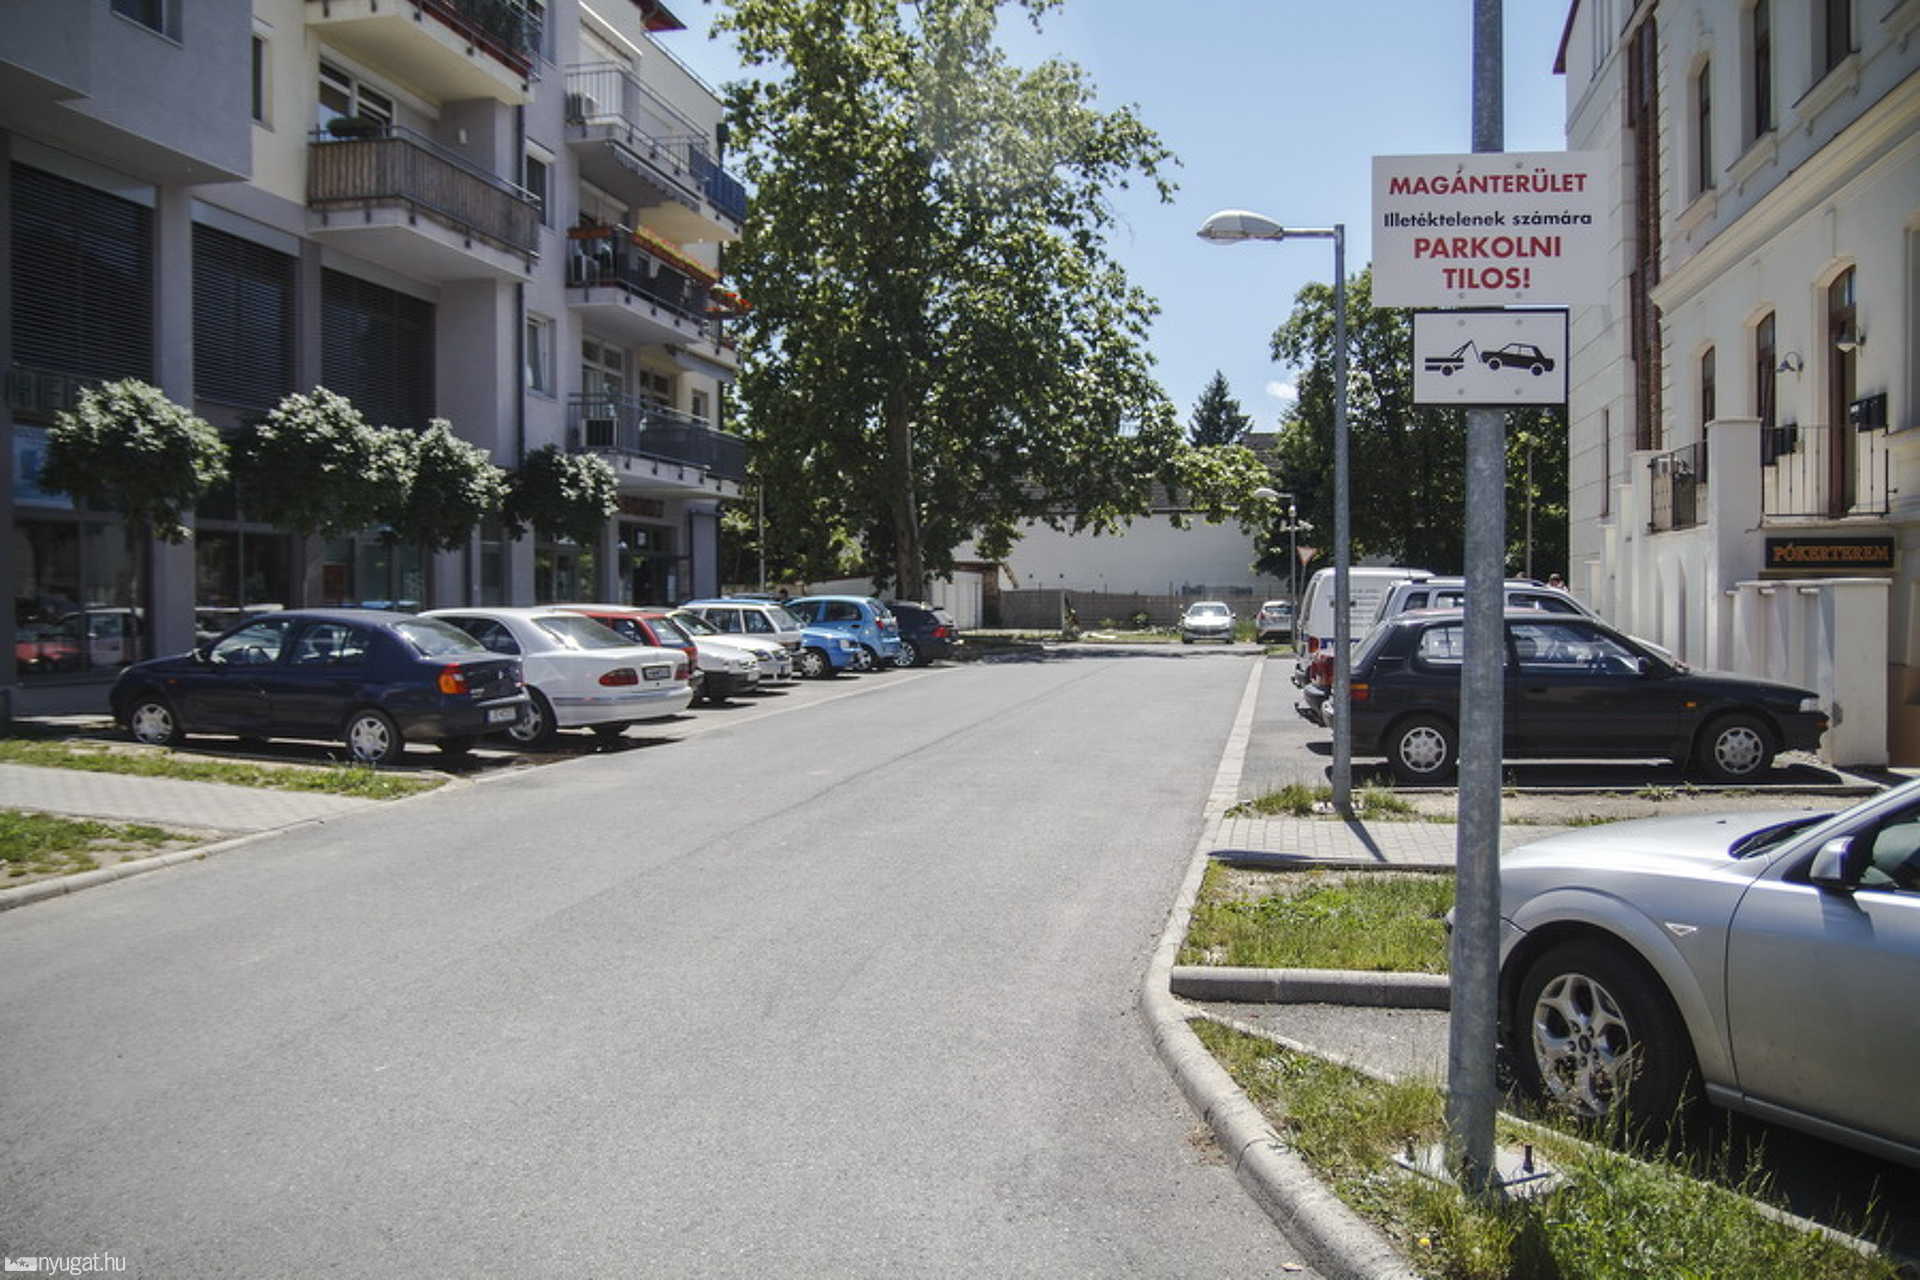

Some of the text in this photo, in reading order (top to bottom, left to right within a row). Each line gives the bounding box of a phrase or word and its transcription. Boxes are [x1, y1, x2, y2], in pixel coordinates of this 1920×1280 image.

[1389, 168, 1587, 195] MAGÁNTERÜLET
[1384, 210, 1592, 227] Illetéktelenek számára
[1414, 236, 1561, 258] PARKOLNI
[1442, 267, 1531, 289] TILOS!
